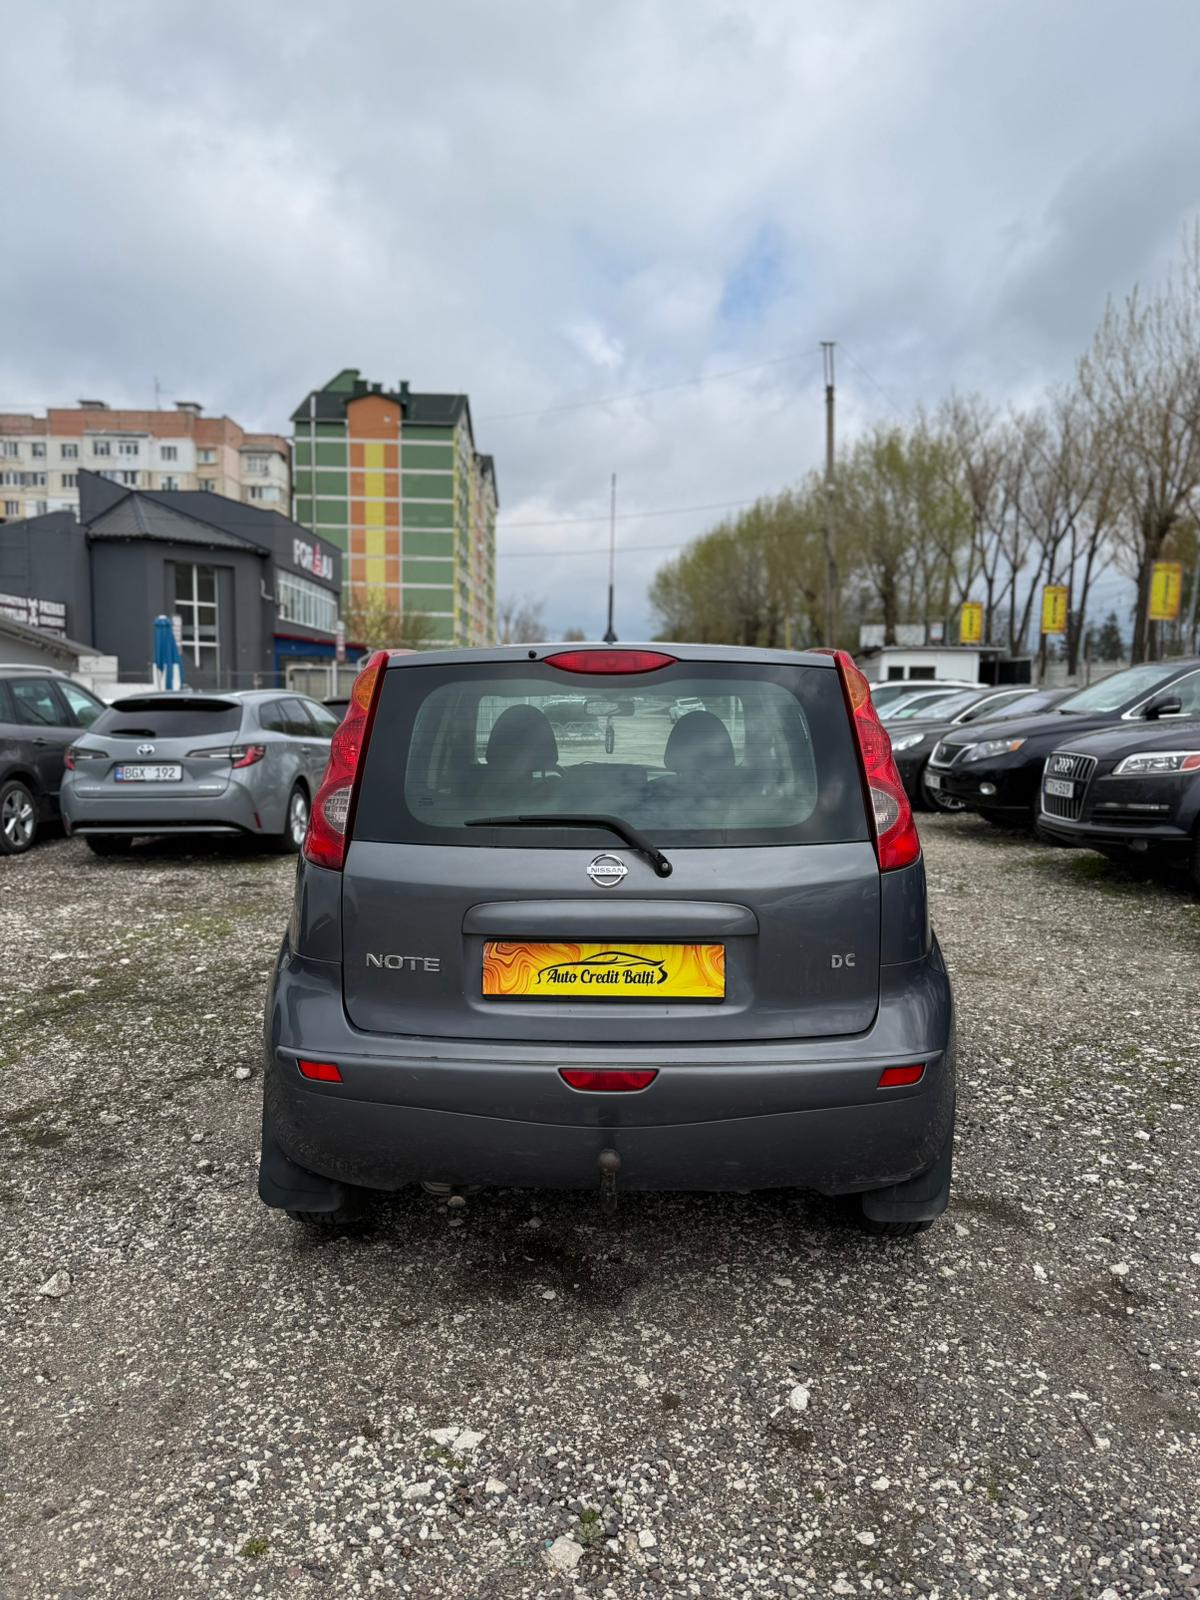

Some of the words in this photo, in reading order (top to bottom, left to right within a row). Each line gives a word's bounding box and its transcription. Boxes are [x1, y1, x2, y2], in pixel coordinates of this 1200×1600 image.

[124, 767, 146, 778] BGX
[154, 767, 176, 778] 192
[366, 952, 441, 972] NOTE
[546, 968, 578, 984] Auto
[580, 968, 621, 984] Credit
